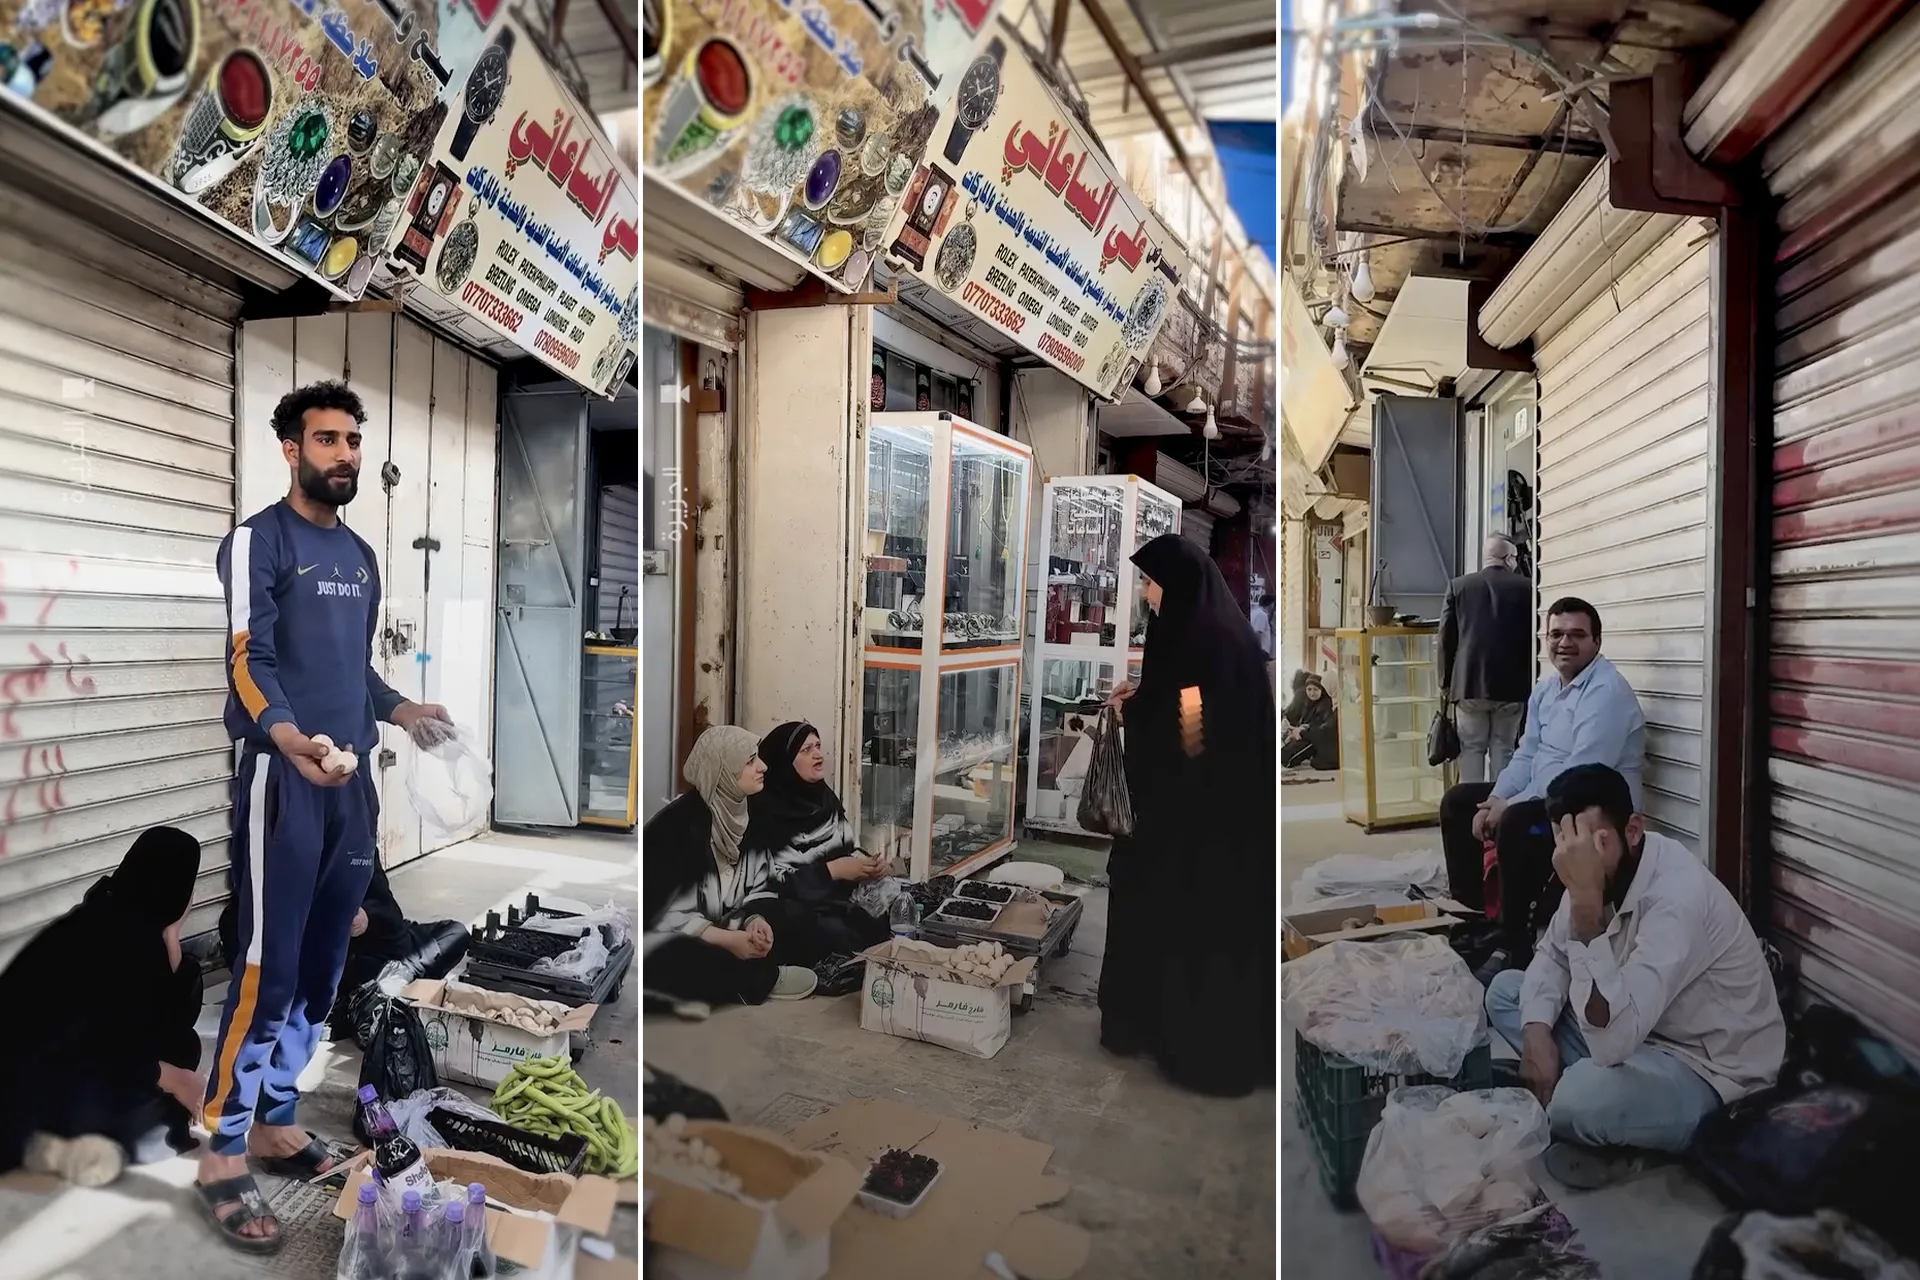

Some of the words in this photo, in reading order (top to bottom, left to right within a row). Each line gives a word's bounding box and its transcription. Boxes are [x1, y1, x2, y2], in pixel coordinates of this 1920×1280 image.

[505, 108, 621, 228] الساعاتي
[1001, 120, 1119, 238] الساعاتي
[495, 239, 520, 271] ROLEX
[994, 243, 1019, 270] ROLEX
[1098, 220, 1147, 275] علي
[461, 280, 524, 333] 07707333662
[516, 288, 542, 315] OMEGA
[569, 326, 585, 344] RADO
[962, 281, 1026, 334] 07707333662
[1017, 291, 1044, 318] OMEGA
[1045, 311, 1073, 338] LONGINES
[1072, 330, 1089, 349] RADO
[1037, 332, 1085, 373] 07809596000
[317, 581, 336, 596] JUST
[338, 582, 351, 597] DO
